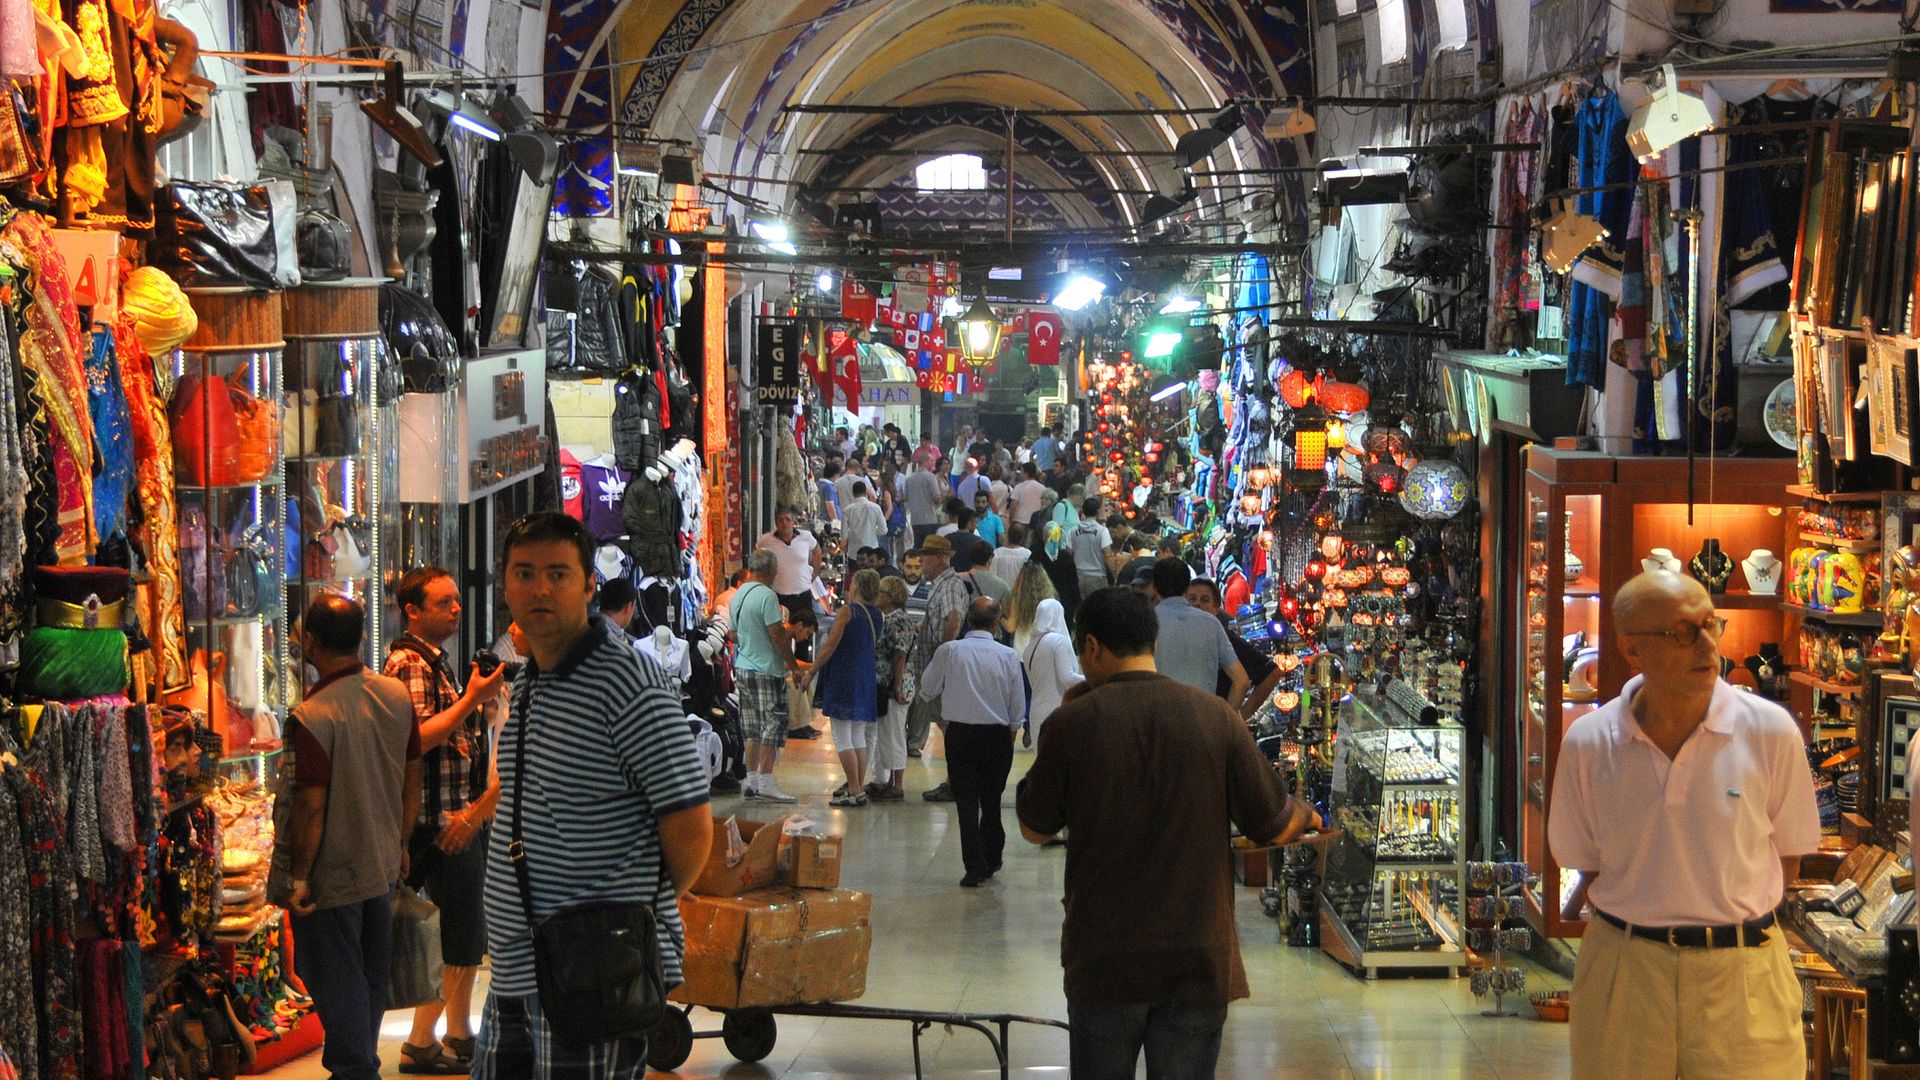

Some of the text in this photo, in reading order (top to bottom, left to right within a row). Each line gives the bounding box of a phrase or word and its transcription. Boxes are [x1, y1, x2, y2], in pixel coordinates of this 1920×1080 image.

[772, 328, 784, 381] EGE
[759, 384, 798, 399] DÖVİZ
[836, 387, 910, 403] OHAN
